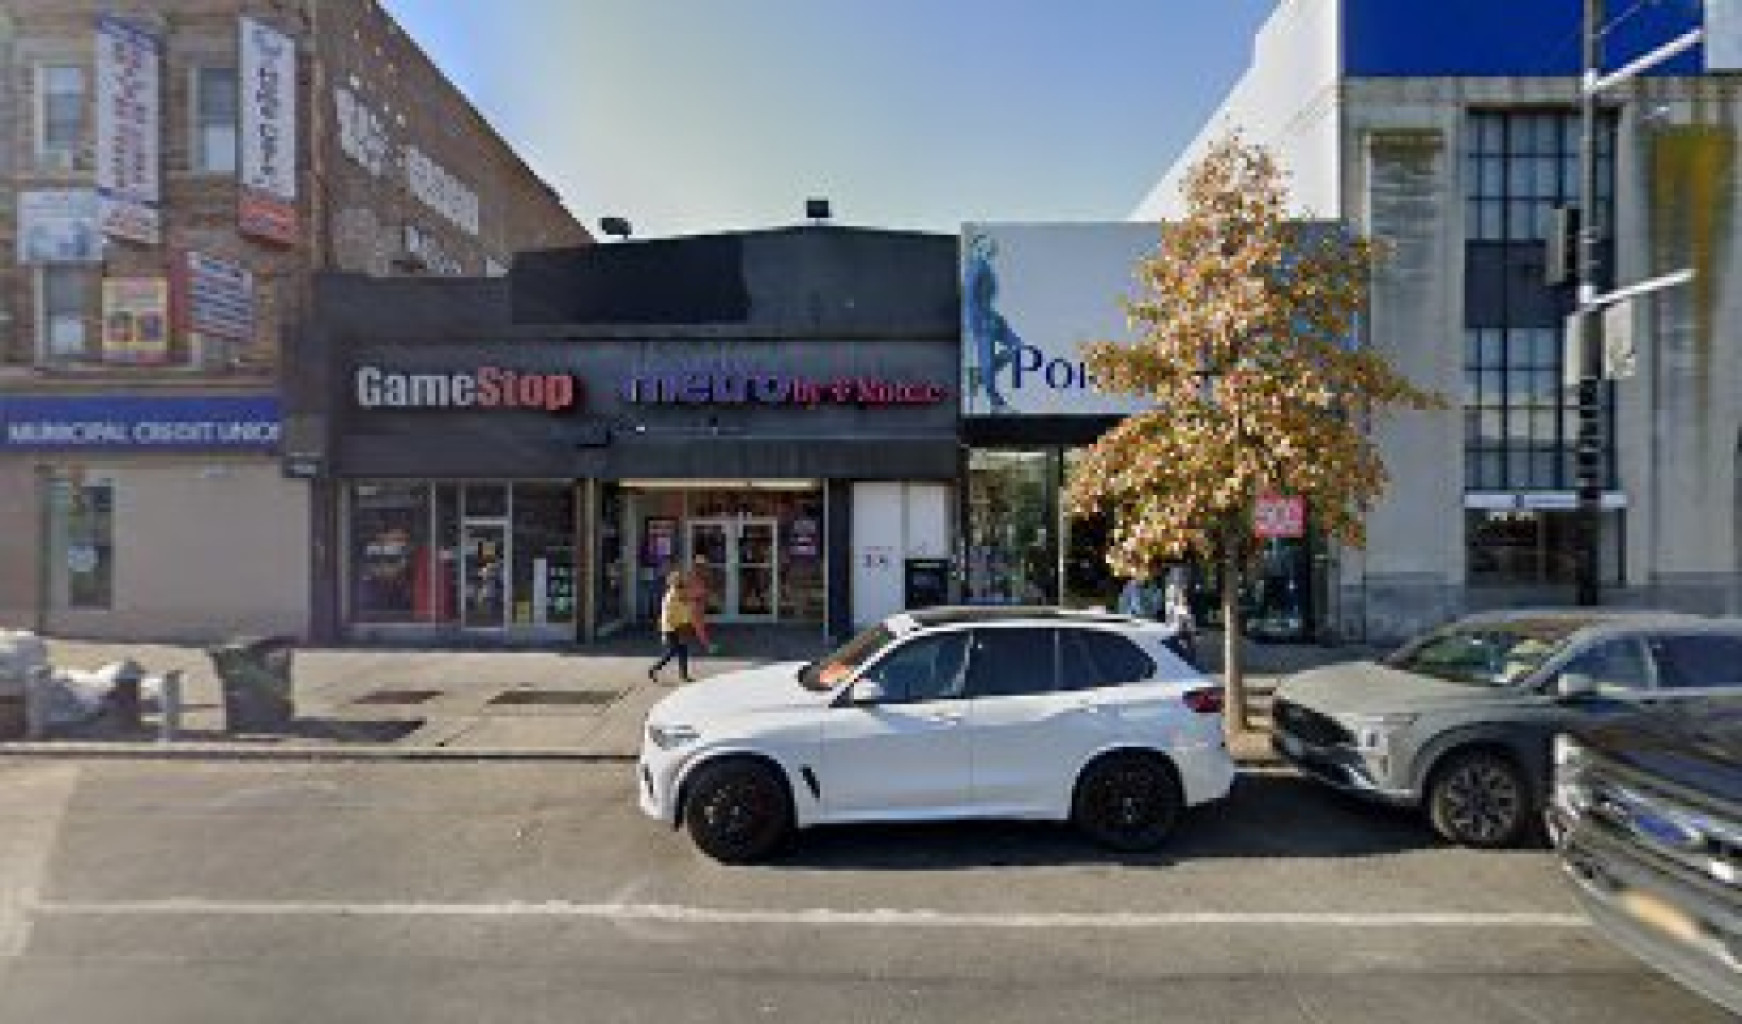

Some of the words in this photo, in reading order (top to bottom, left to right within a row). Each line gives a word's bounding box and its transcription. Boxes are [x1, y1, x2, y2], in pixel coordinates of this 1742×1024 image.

[356, 366, 574, 412] GameStop
[622, 364, 788, 404] metro
[8, 421, 127, 444] MUNICIPAL
[132, 421, 214, 444] CREDIT
